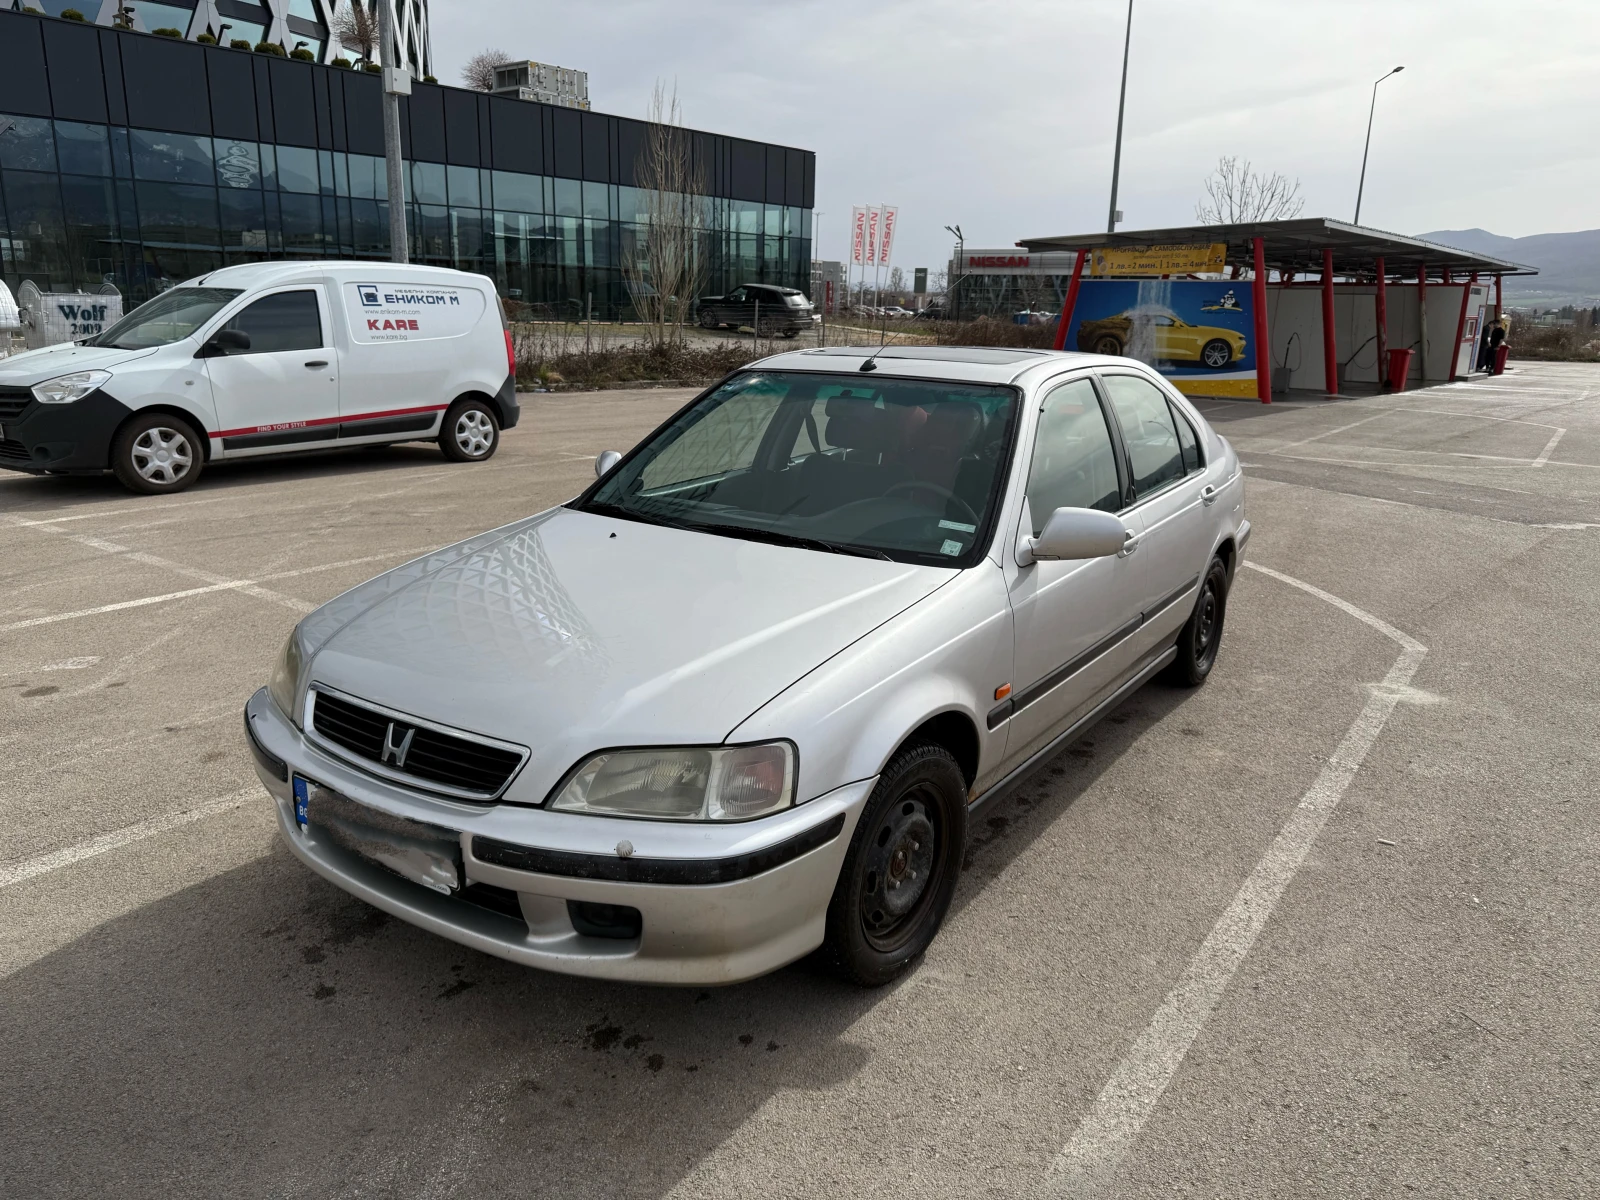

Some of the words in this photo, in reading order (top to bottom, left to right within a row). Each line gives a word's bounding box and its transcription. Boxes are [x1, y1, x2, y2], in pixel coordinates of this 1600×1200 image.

[855, 212, 865, 261] NISSAN
[867, 211, 879, 262] NISSAN
[880, 211, 895, 262] NISSAN
[969, 256, 1030, 268] NISSAN
[384, 294, 446, 305] ЕНИКОМ
[451, 296, 460, 305] М
[58, 304, 108, 322] Wolf
[70, 323, 102, 335] 2009
[366, 319, 420, 331] KARE
